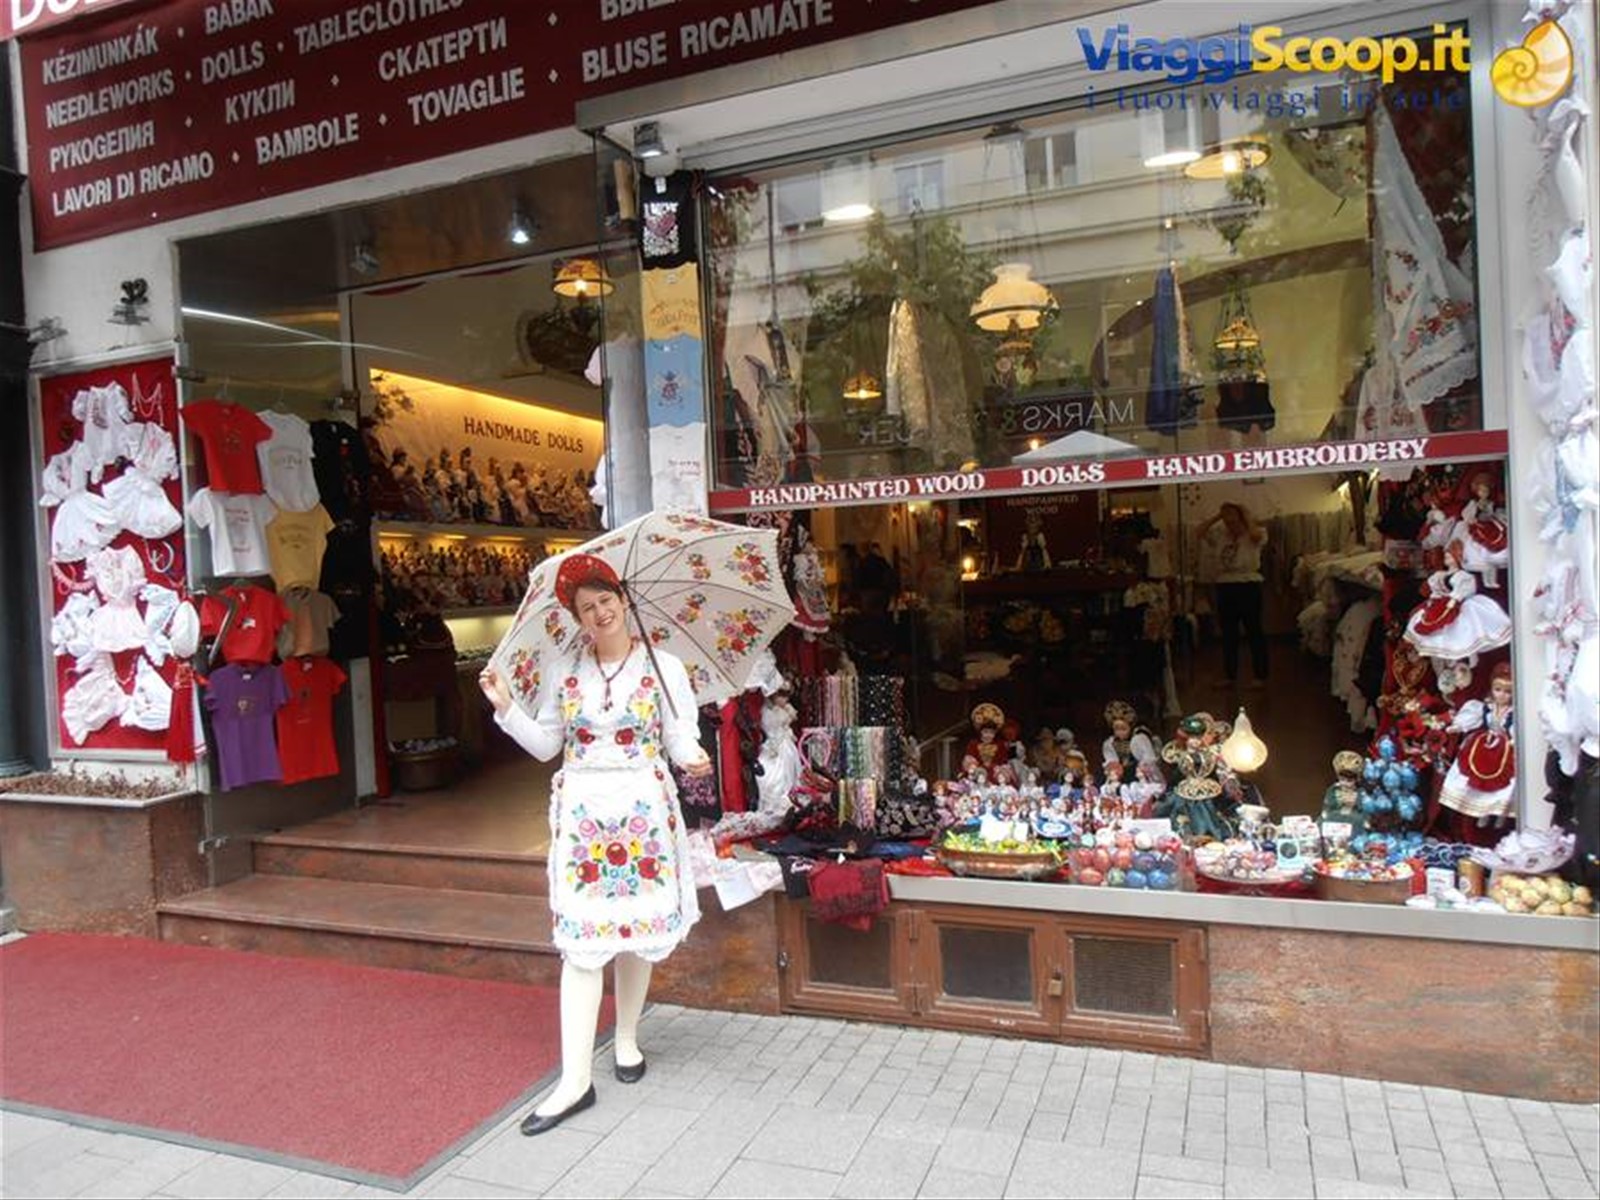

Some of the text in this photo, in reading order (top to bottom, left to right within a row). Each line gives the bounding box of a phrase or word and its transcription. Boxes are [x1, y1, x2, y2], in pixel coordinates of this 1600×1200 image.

[42, 24, 159, 85] KÉZIMUNKÁK
[379, 17, 507, 81] СКАТЕРТИ
[46, 69, 175, 129] NEEDLEWORKS
[201, 41, 265, 84] DOLLS
[52, 0, 834, 217] LAVORI DI RICAMO BAMBOLE TOVAGLIE BLUSE RICAMATE
[464, 416, 584, 453] HANDMADE DOLLS
[1146, 438, 1429, 479] HAND EMBROIDERY
[750, 472, 986, 507] HANDPAINTED WOOD
[1021, 462, 1106, 487] DOLLS
